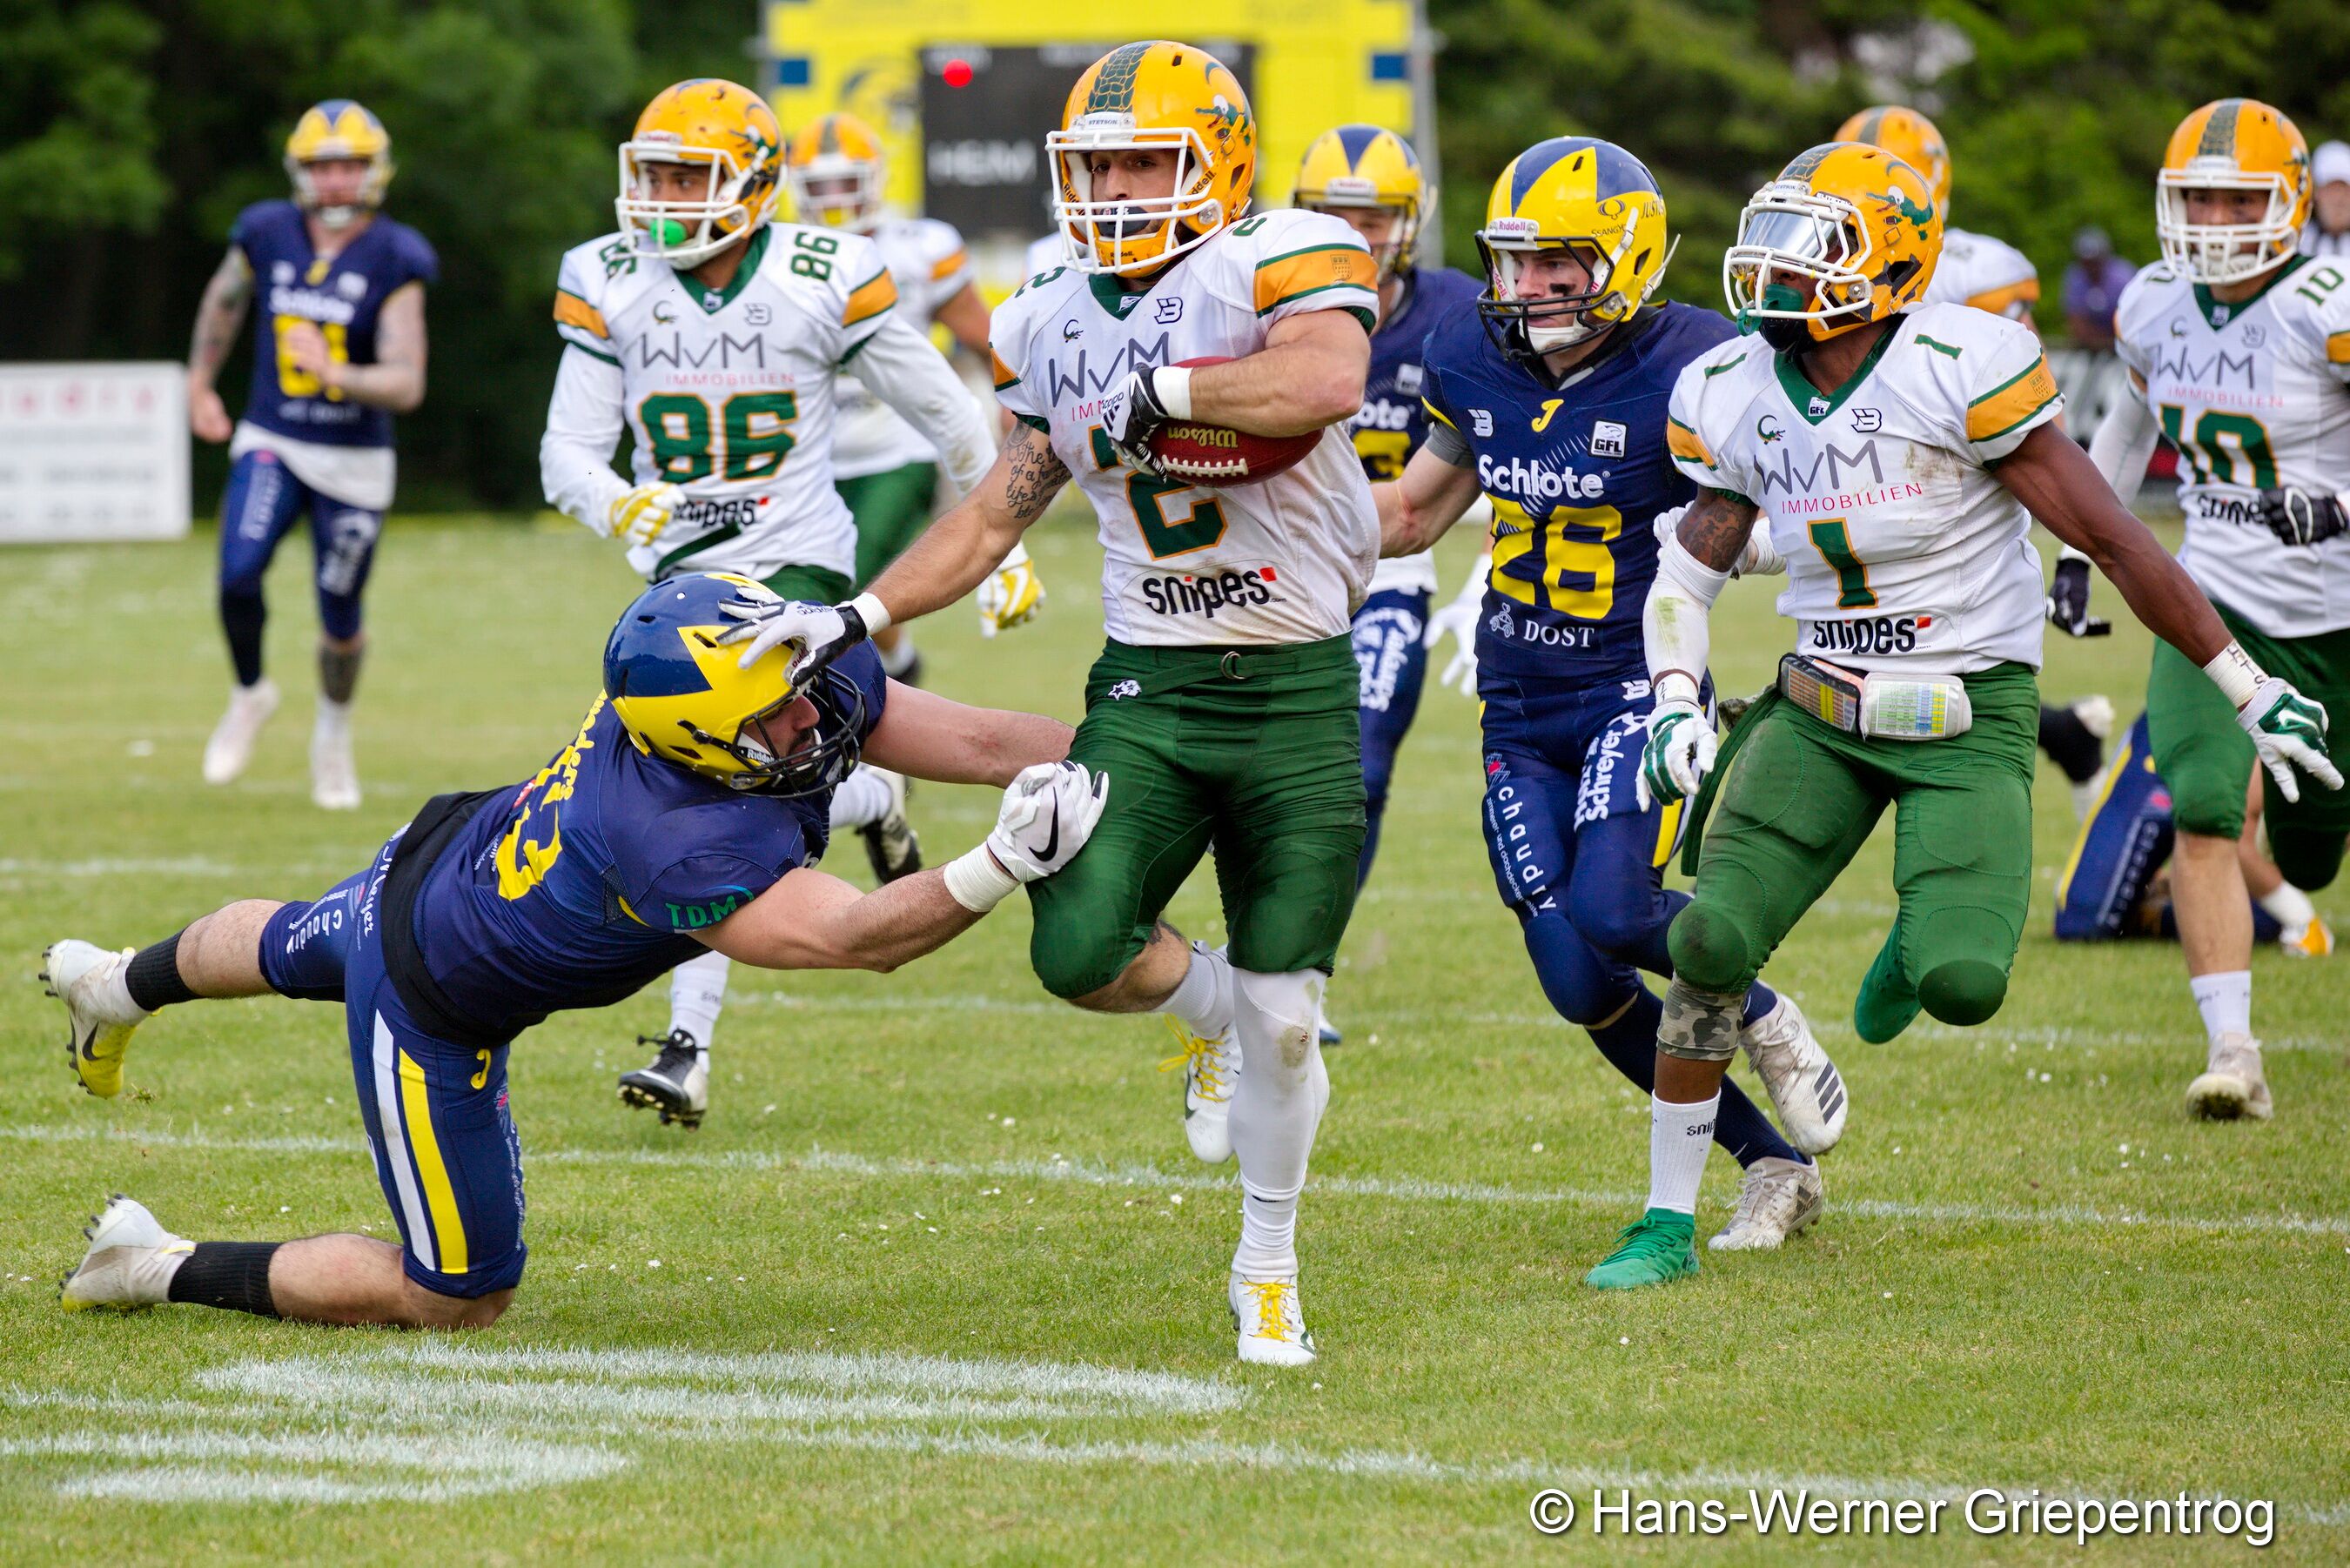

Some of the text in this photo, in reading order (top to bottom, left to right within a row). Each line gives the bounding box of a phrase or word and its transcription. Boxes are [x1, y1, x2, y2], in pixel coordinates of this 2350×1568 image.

[1499, 219, 1526, 232] Riddell
[789, 231, 839, 282] 86
[2296, 266, 2346, 306] 10
[1704, 352, 1749, 380] 1
[1914, 333, 1963, 361] 1
[665, 372, 796, 386] IMMOBILIEN
[2167, 387, 2285, 409] IMMOBILIEN
[638, 391, 799, 485] 86
[1167, 426, 1239, 448] Wilson
[1594, 438, 1623, 453] GFL
[2159, 402, 2282, 487] 10
[1088, 423, 1229, 561] 2
[1781, 481, 1924, 515] IMMOBILIEN
[1807, 517, 1878, 610] 1
[1142, 570, 1270, 619] snipes
[1523, 619, 1595, 648] DOST
[1812, 617, 1916, 655] snipes
[1585, 729, 1625, 821] Schreyer
[1498, 786, 1557, 910] chaudry
